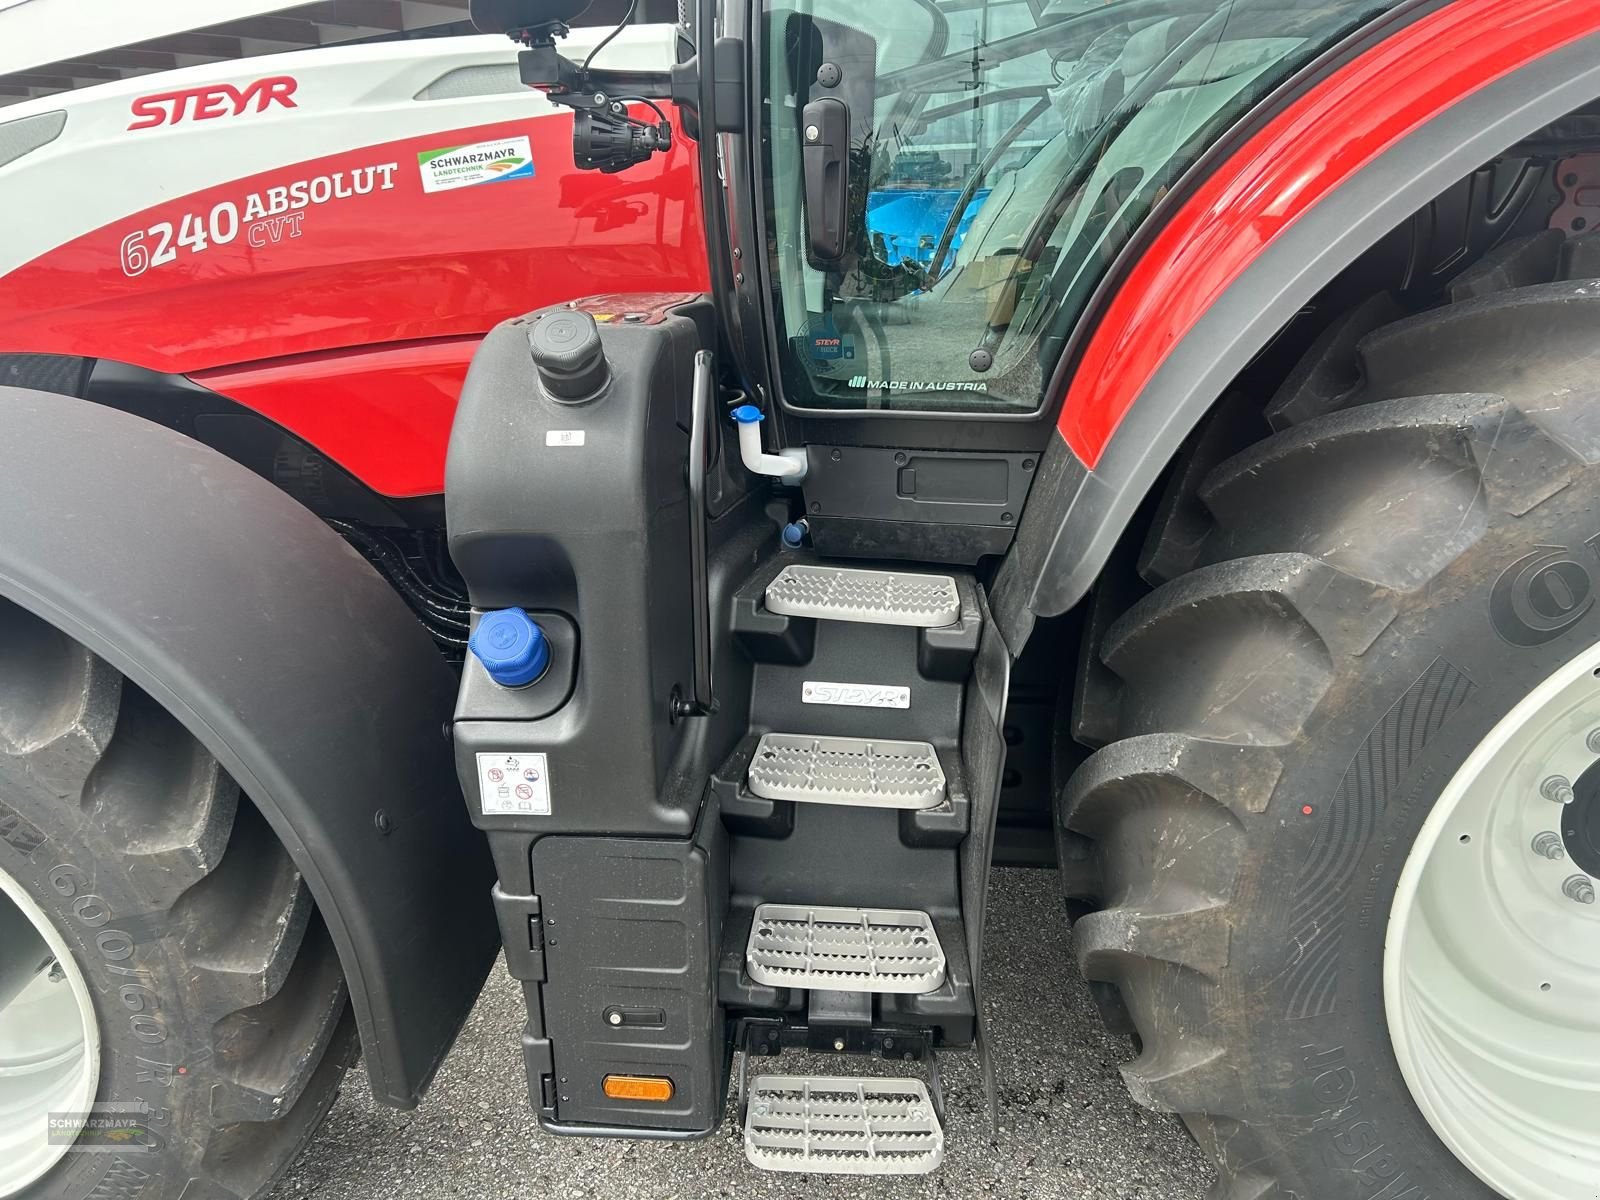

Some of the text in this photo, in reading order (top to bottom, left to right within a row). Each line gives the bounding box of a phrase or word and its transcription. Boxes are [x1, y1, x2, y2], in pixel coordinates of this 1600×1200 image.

[126, 75, 298, 131] STEYR
[430, 147, 515, 169] SCHWARZMAYR
[433, 164, 484, 177] LANDTECHNIK
[120, 162, 398, 277] 6240 ABSOLUT
[248, 212, 304, 248] CVT
[815, 338, 840, 346] STEYR
[866, 380, 988, 391] MADE IN AUSTRIA
[813, 684, 901, 707] STEYR
